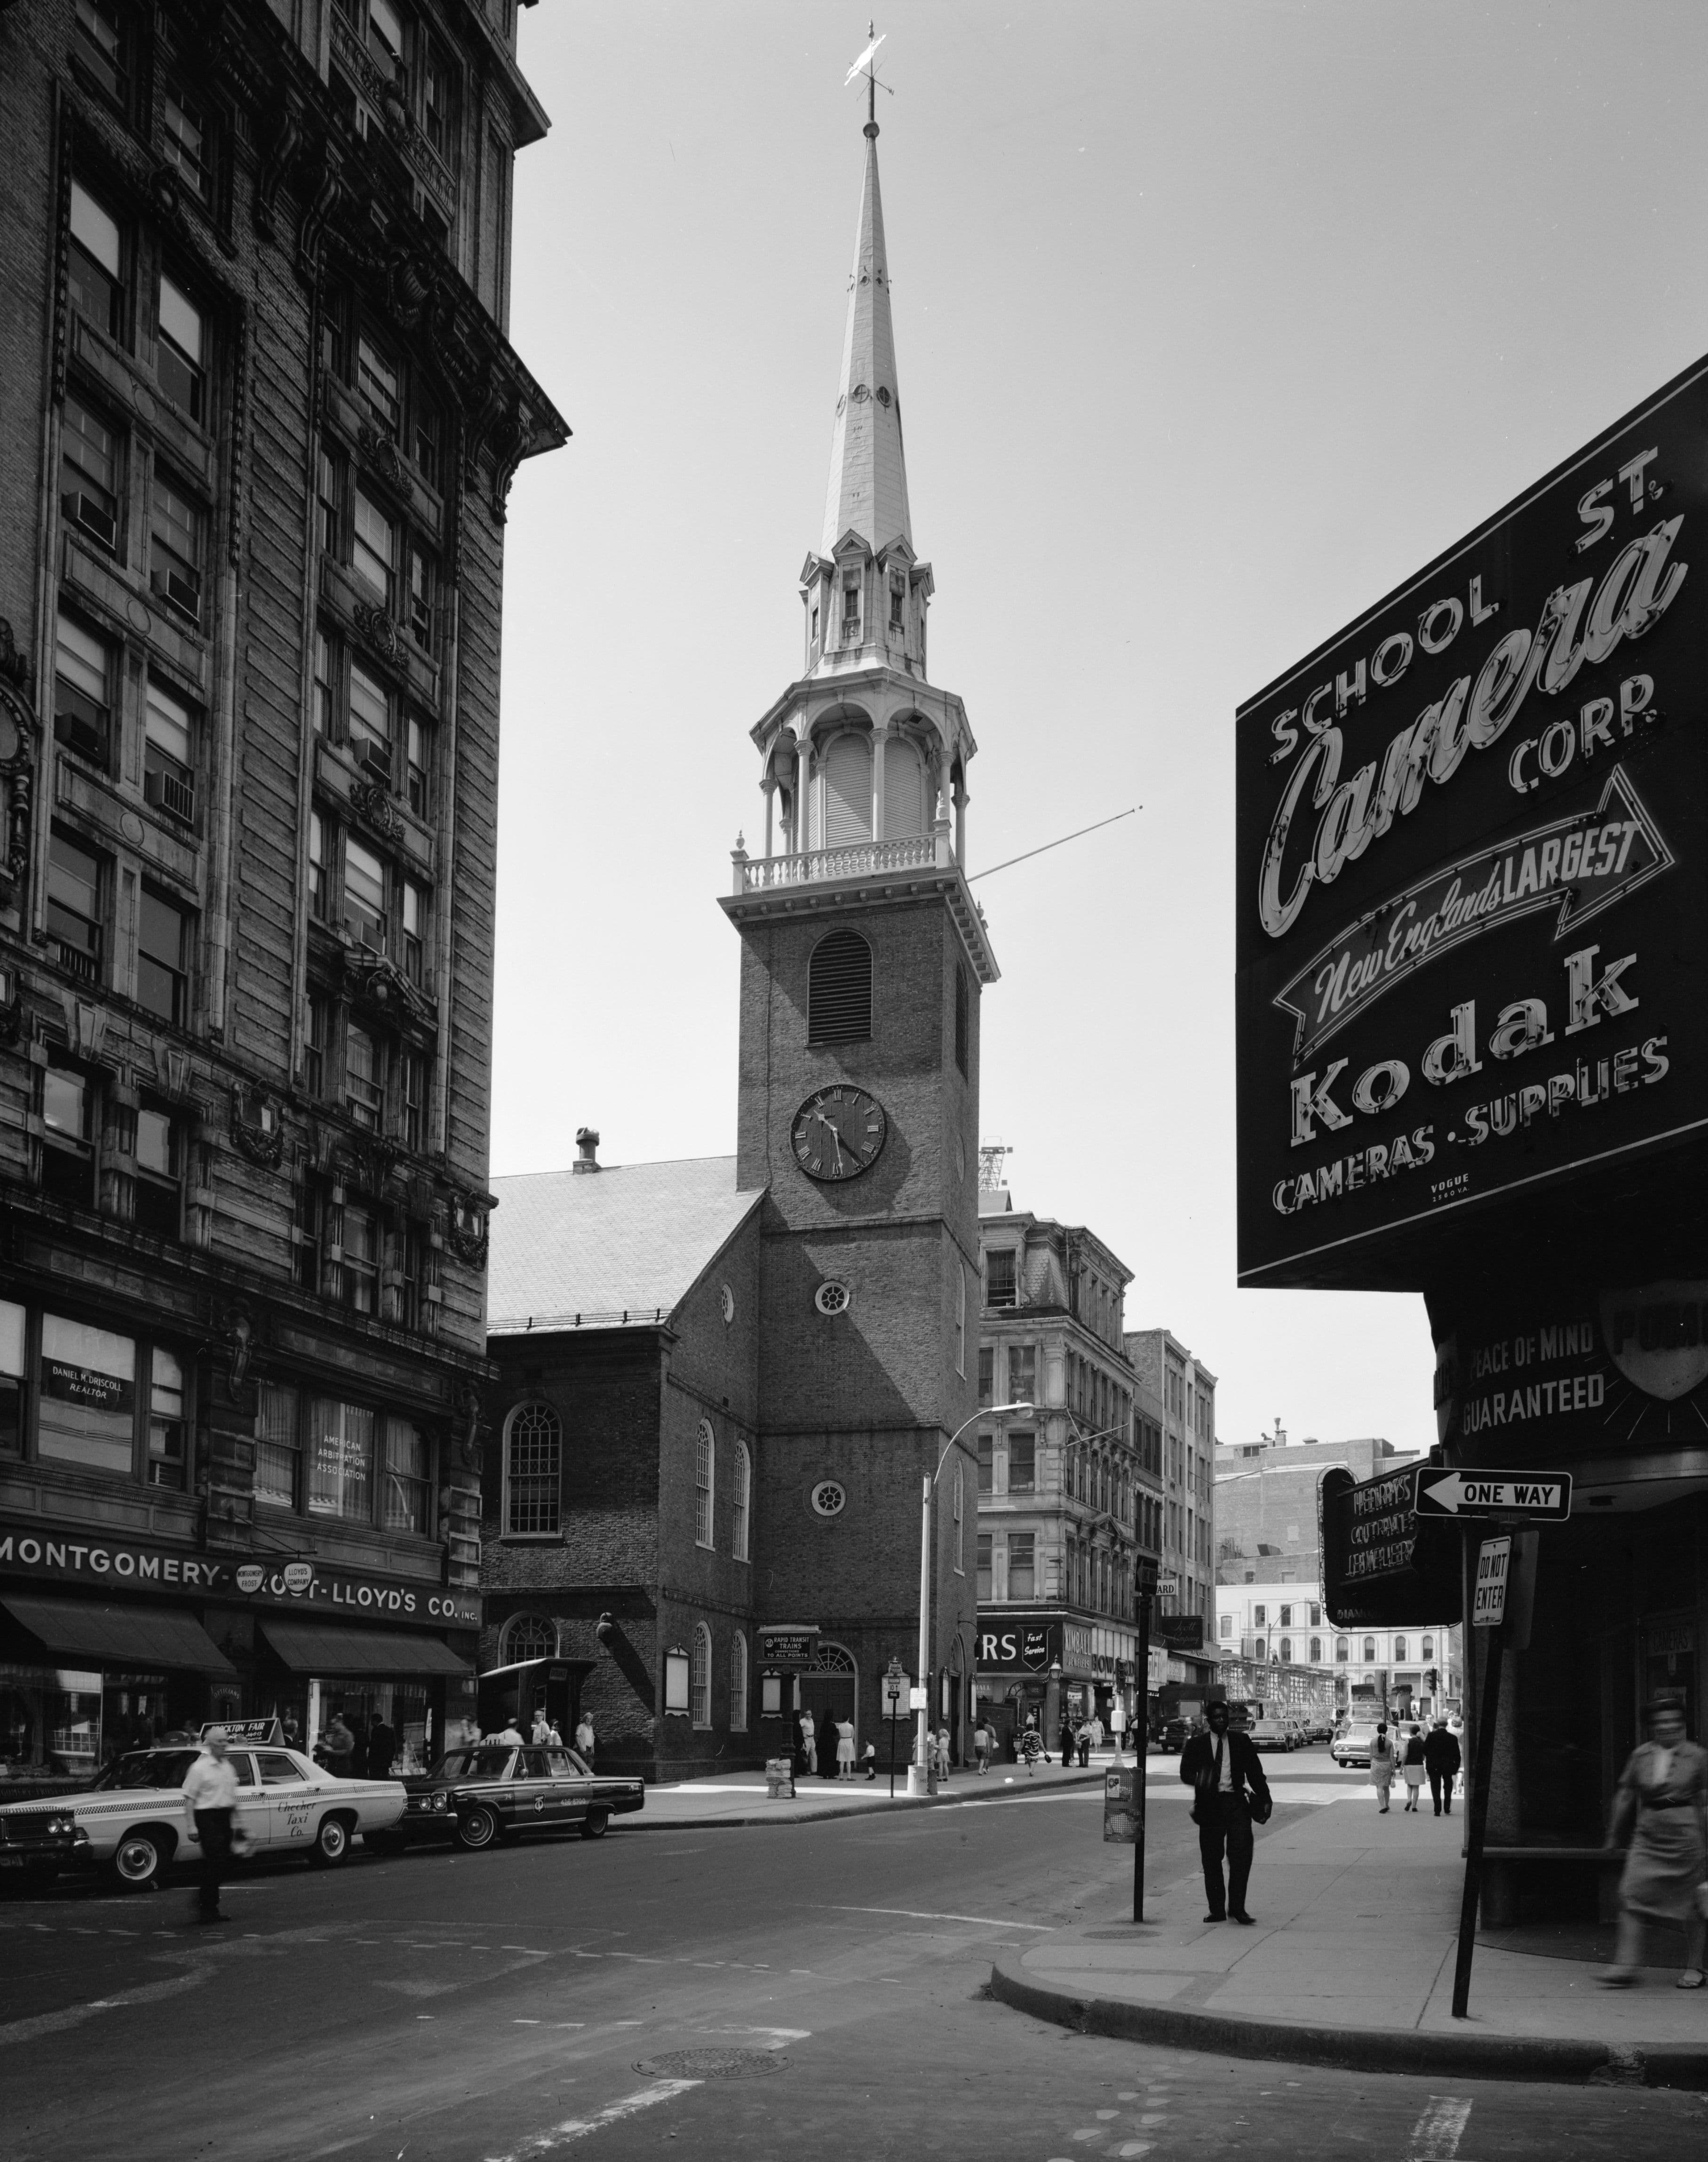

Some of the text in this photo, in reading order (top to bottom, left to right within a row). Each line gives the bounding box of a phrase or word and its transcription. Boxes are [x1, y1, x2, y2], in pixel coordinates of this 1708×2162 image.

[1269, 445, 1664, 766] SCHOOL ST.
[1258, 513, 1690, 938] Camera
[1508, 673, 1660, 794] CORP.
[1315, 947, 1384, 1024] New
[1502, 819, 1643, 905] LARGEST
[1289, 944, 1640, 1148] Kodak
[1272, 1035, 1670, 1215] CAMERAS SUPPLIES
[1430, 1172, 1470, 1194] VOGUE
[1432, 1189, 1456, 1202] 2560
[1470, 1340, 1509, 1382] PEACE
[1514, 1336, 1535, 1368] OF
[1540, 1322, 1594, 1362] MIND
[53, 1366, 123, 1392] DANIEL M. DRISCOLL
[69, 1383, 107, 1399] REALTOR
[1462, 1373, 1605, 1437] GUARANTEED
[324, 1435, 361, 1451] AMERICAN
[318, 1448, 365, 1467] ARBITRATION
[317, 1463, 365, 1481] ASSOCIATION
[1464, 1484, 1554, 1505] ONE WAY
[1479, 1553, 1508, 1580] DO NOT
[1476, 1585, 1504, 1610] ENTER
[428, 1598, 458, 1618] CO.
[461, 1612, 477, 1621] INC.
[977, 1634, 1017, 1660] RS
[1027, 1633, 1043, 1642] Fast
[1065, 1629, 1091, 1656] KIMBALL
[1024, 1645, 1045, 1656] Service
[1068, 1656, 1089, 1670] JEWELERS
[214, 1687, 240, 1700] OPTICIANS
[248, 1722, 266, 1732] FAIR
[278, 1800, 317, 1812] Checker
[286, 1812, 309, 1825] Taxi
[290, 1826, 304, 1837] Co.
